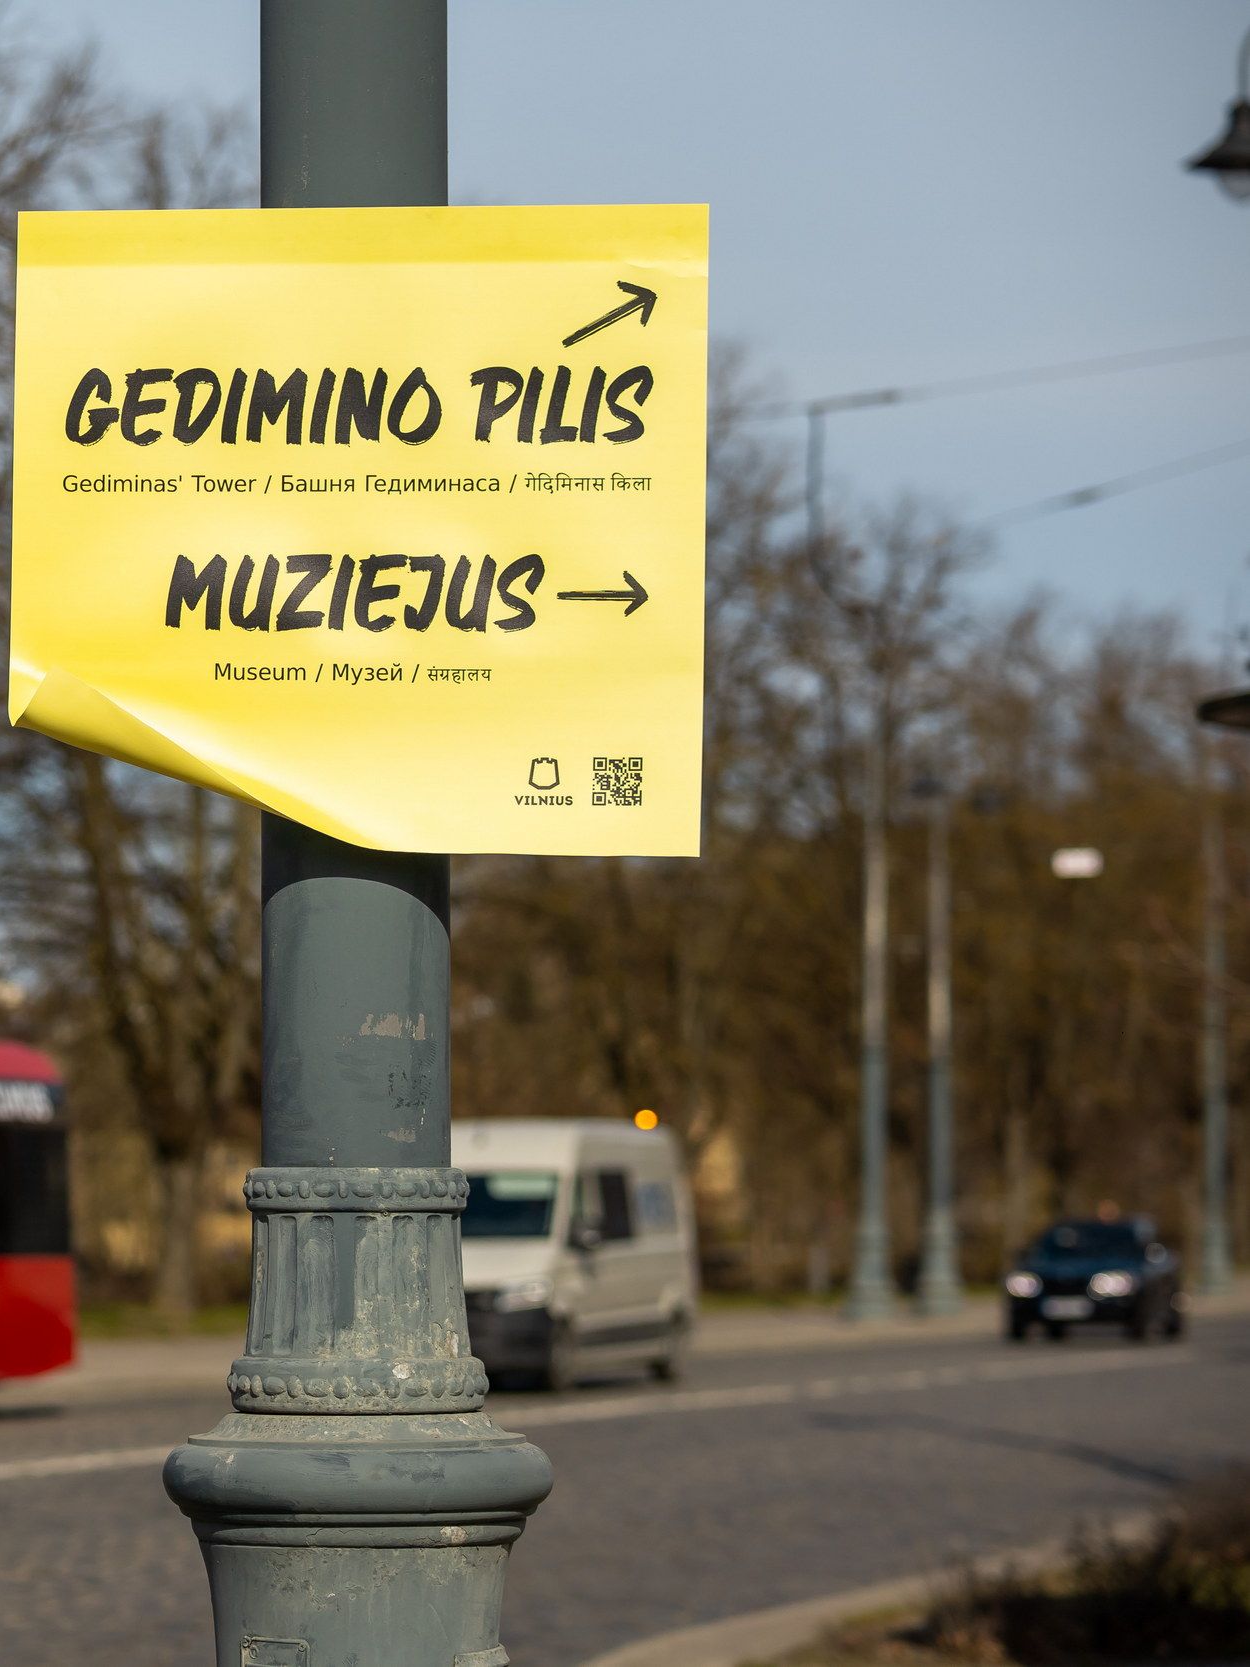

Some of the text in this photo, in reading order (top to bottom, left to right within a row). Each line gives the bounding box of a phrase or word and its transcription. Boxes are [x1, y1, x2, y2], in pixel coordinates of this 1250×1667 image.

[65, 365, 654, 447] GEDIMINO PILIS
[63, 475, 182, 493] Gediminas'
[191, 475, 257, 493] Tower
[264, 475, 273, 495] /
[282, 475, 355, 493] Башня
[366, 475, 500, 495] Гедиминаса
[509, 475, 518, 495] /
[610, 472, 652, 491] किला
[165, 554, 545, 633] MUZIEJUS
[214, 663, 492, 686] Museum / Музей / संग्रहालय
[514, 795, 574, 806] VILNIUS
